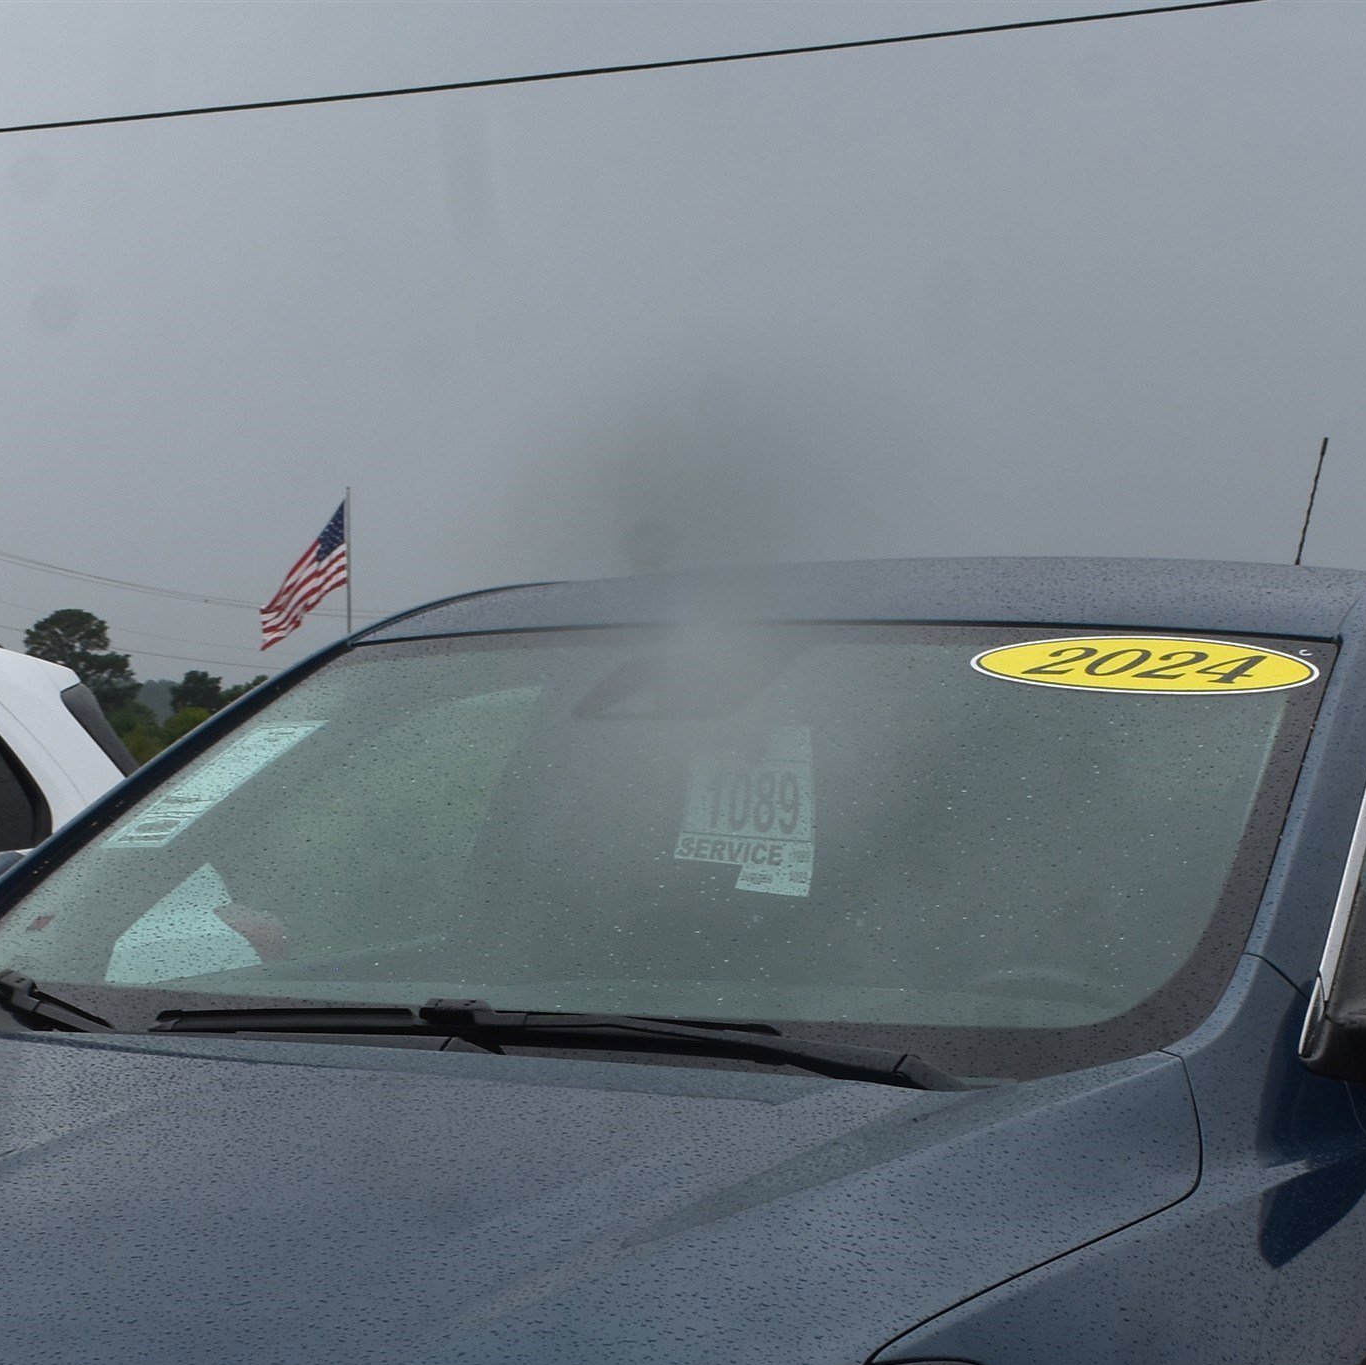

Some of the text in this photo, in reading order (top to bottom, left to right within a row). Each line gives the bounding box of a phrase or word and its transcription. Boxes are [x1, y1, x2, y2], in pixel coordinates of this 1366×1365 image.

[1022, 646, 1268, 685] 2024
[703, 769, 800, 835] 1089
[676, 836, 784, 866] SERVICE
